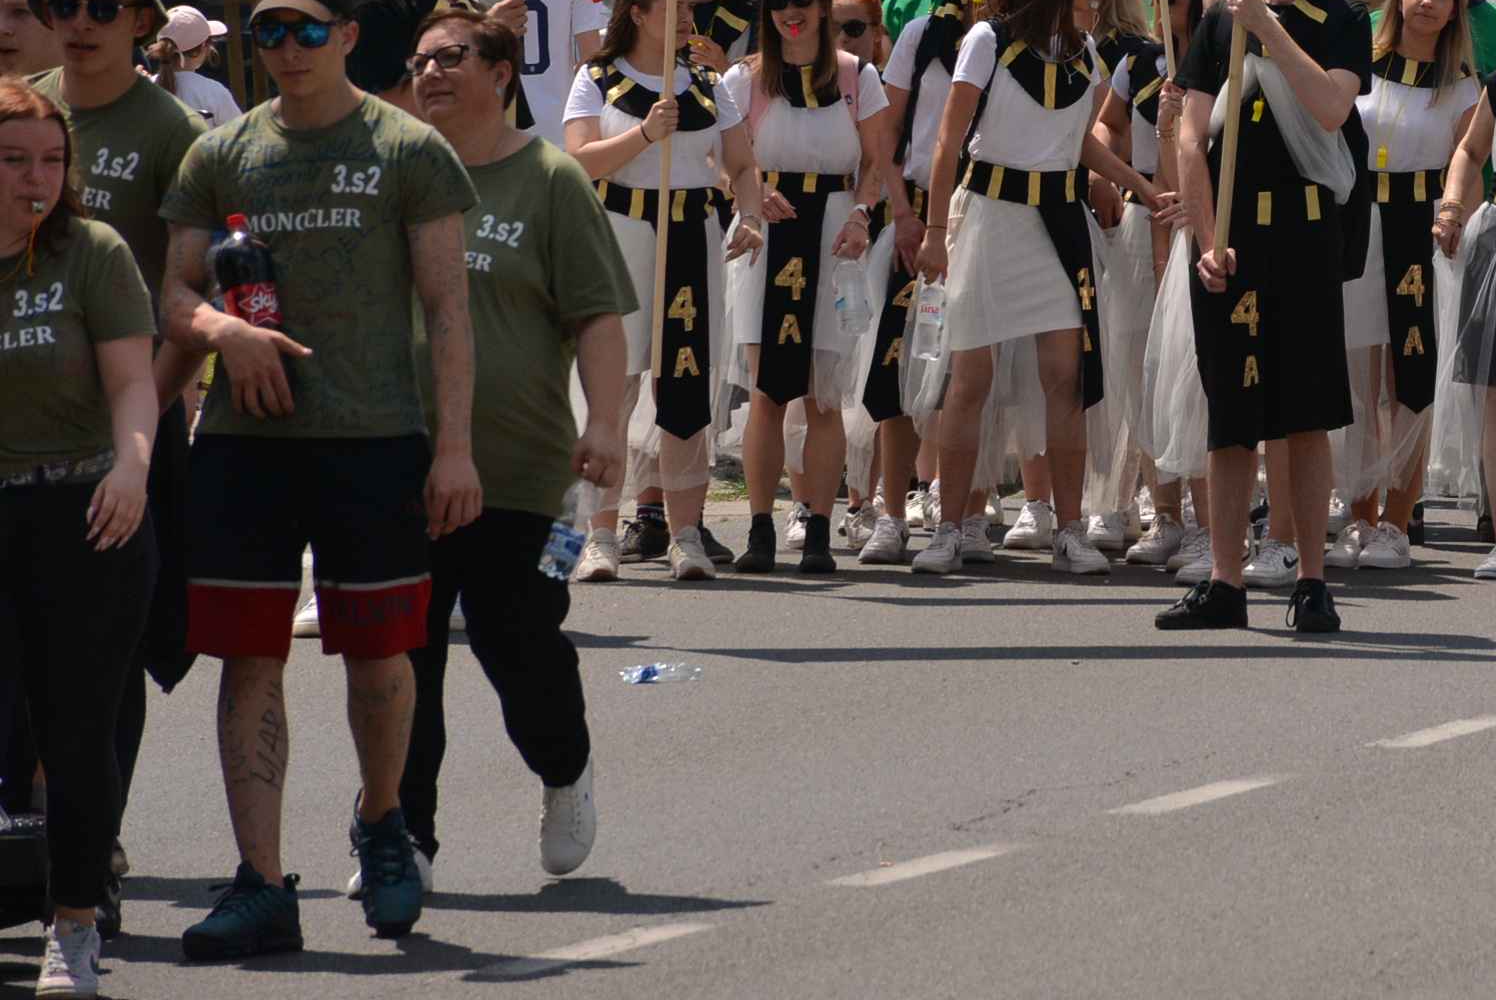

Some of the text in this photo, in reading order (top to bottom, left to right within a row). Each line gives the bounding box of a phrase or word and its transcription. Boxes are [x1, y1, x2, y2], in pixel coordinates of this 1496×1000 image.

[91, 147, 140, 181] 3.s2
[331, 164, 381, 195] 3.s2
[476, 214, 524, 248] 3.s2
[774, 257, 806, 300] 4
[1396, 264, 1425, 307] 4
[13, 281, 64, 317] 3.s2
[668, 286, 697, 331] 4
[1231, 290, 1260, 336] 4
[778, 314, 802, 344] A
[1403, 326, 1425, 356] A
[673, 346, 700, 378] A
[1243, 355, 1260, 387] A
